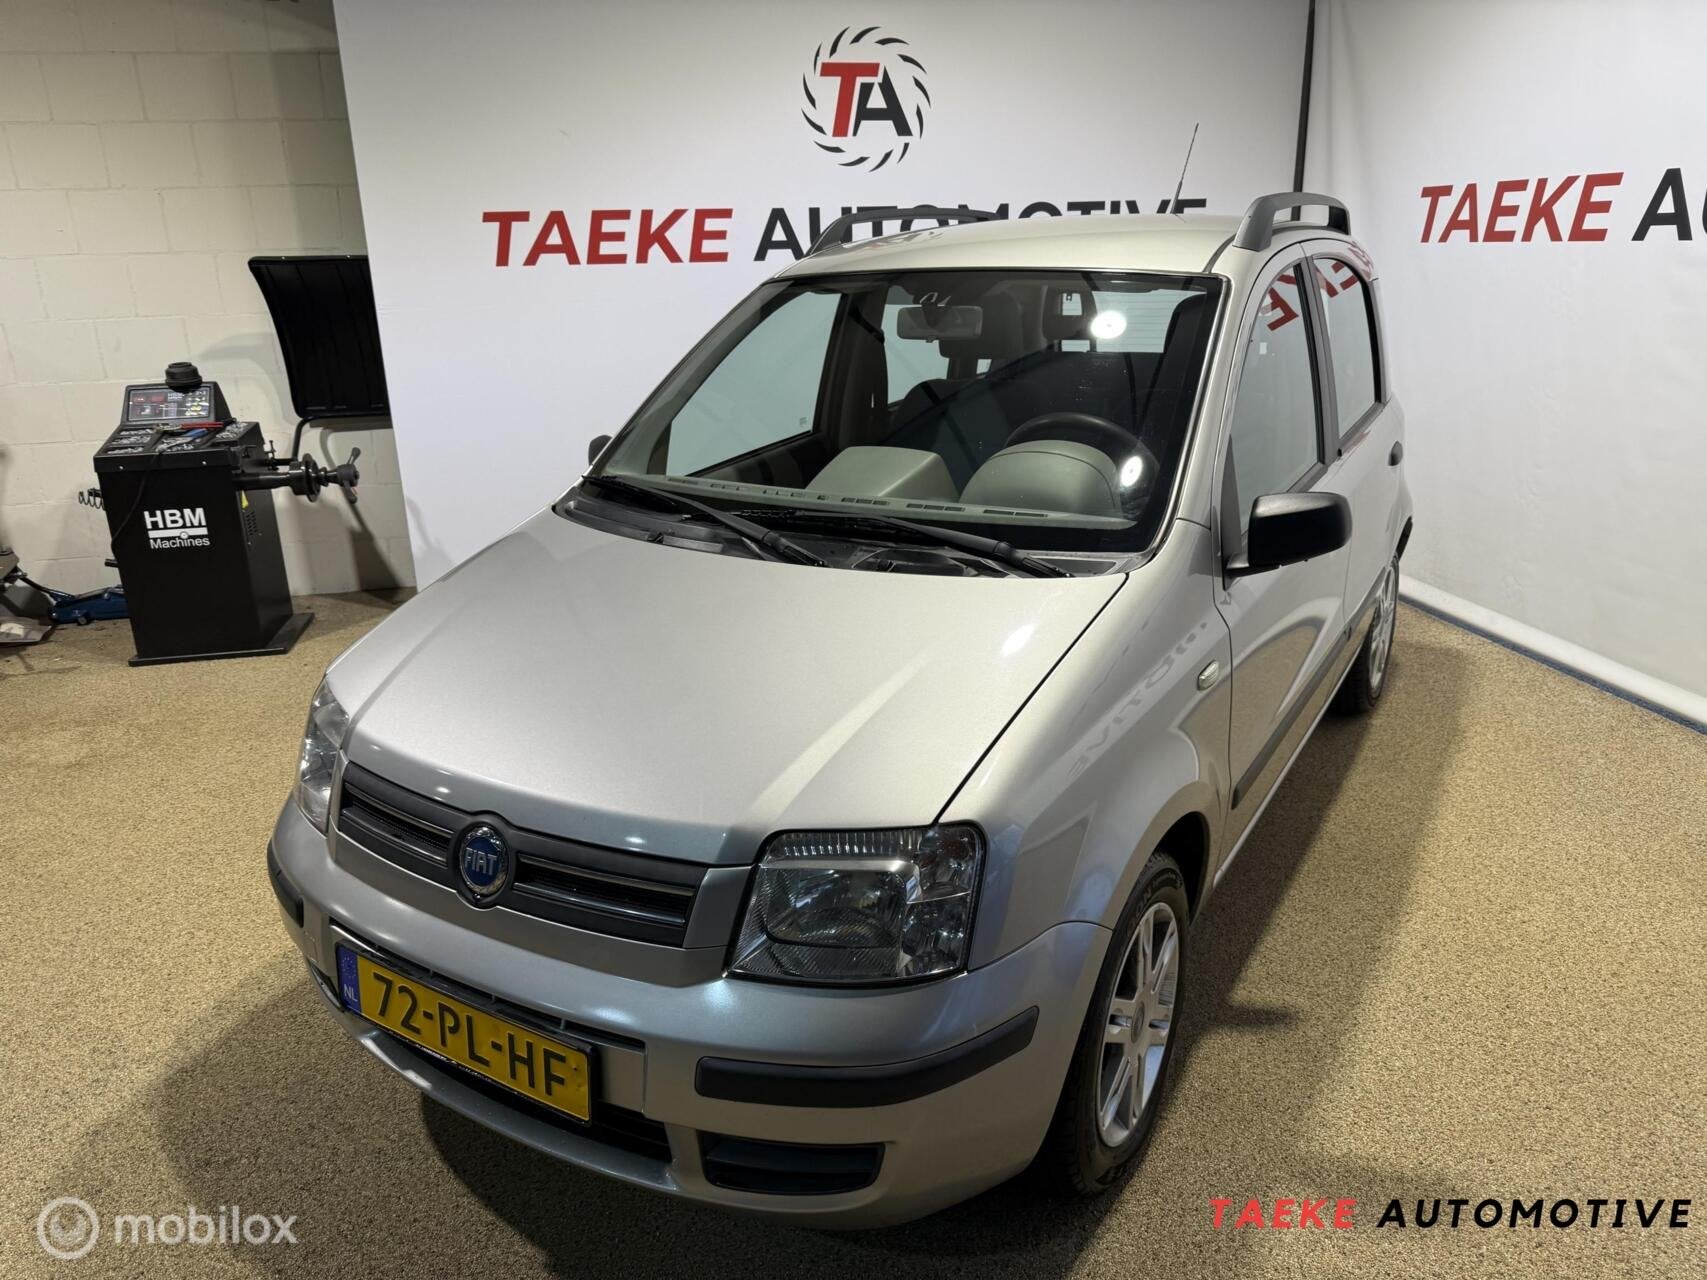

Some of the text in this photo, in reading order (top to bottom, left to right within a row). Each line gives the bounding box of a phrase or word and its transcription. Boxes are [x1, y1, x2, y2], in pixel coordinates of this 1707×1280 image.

[819, 61, 914, 138] TA
[1420, 167, 1707, 243] TAEKE A
[482, 207, 734, 268] TAEKE
[144, 507, 207, 529] HBM
[149, 537, 211, 549] Machines
[464, 847, 497, 875] FIAT
[343, 983, 358, 1002] NL
[372, 971, 567, 1097] 72-PL-HF
